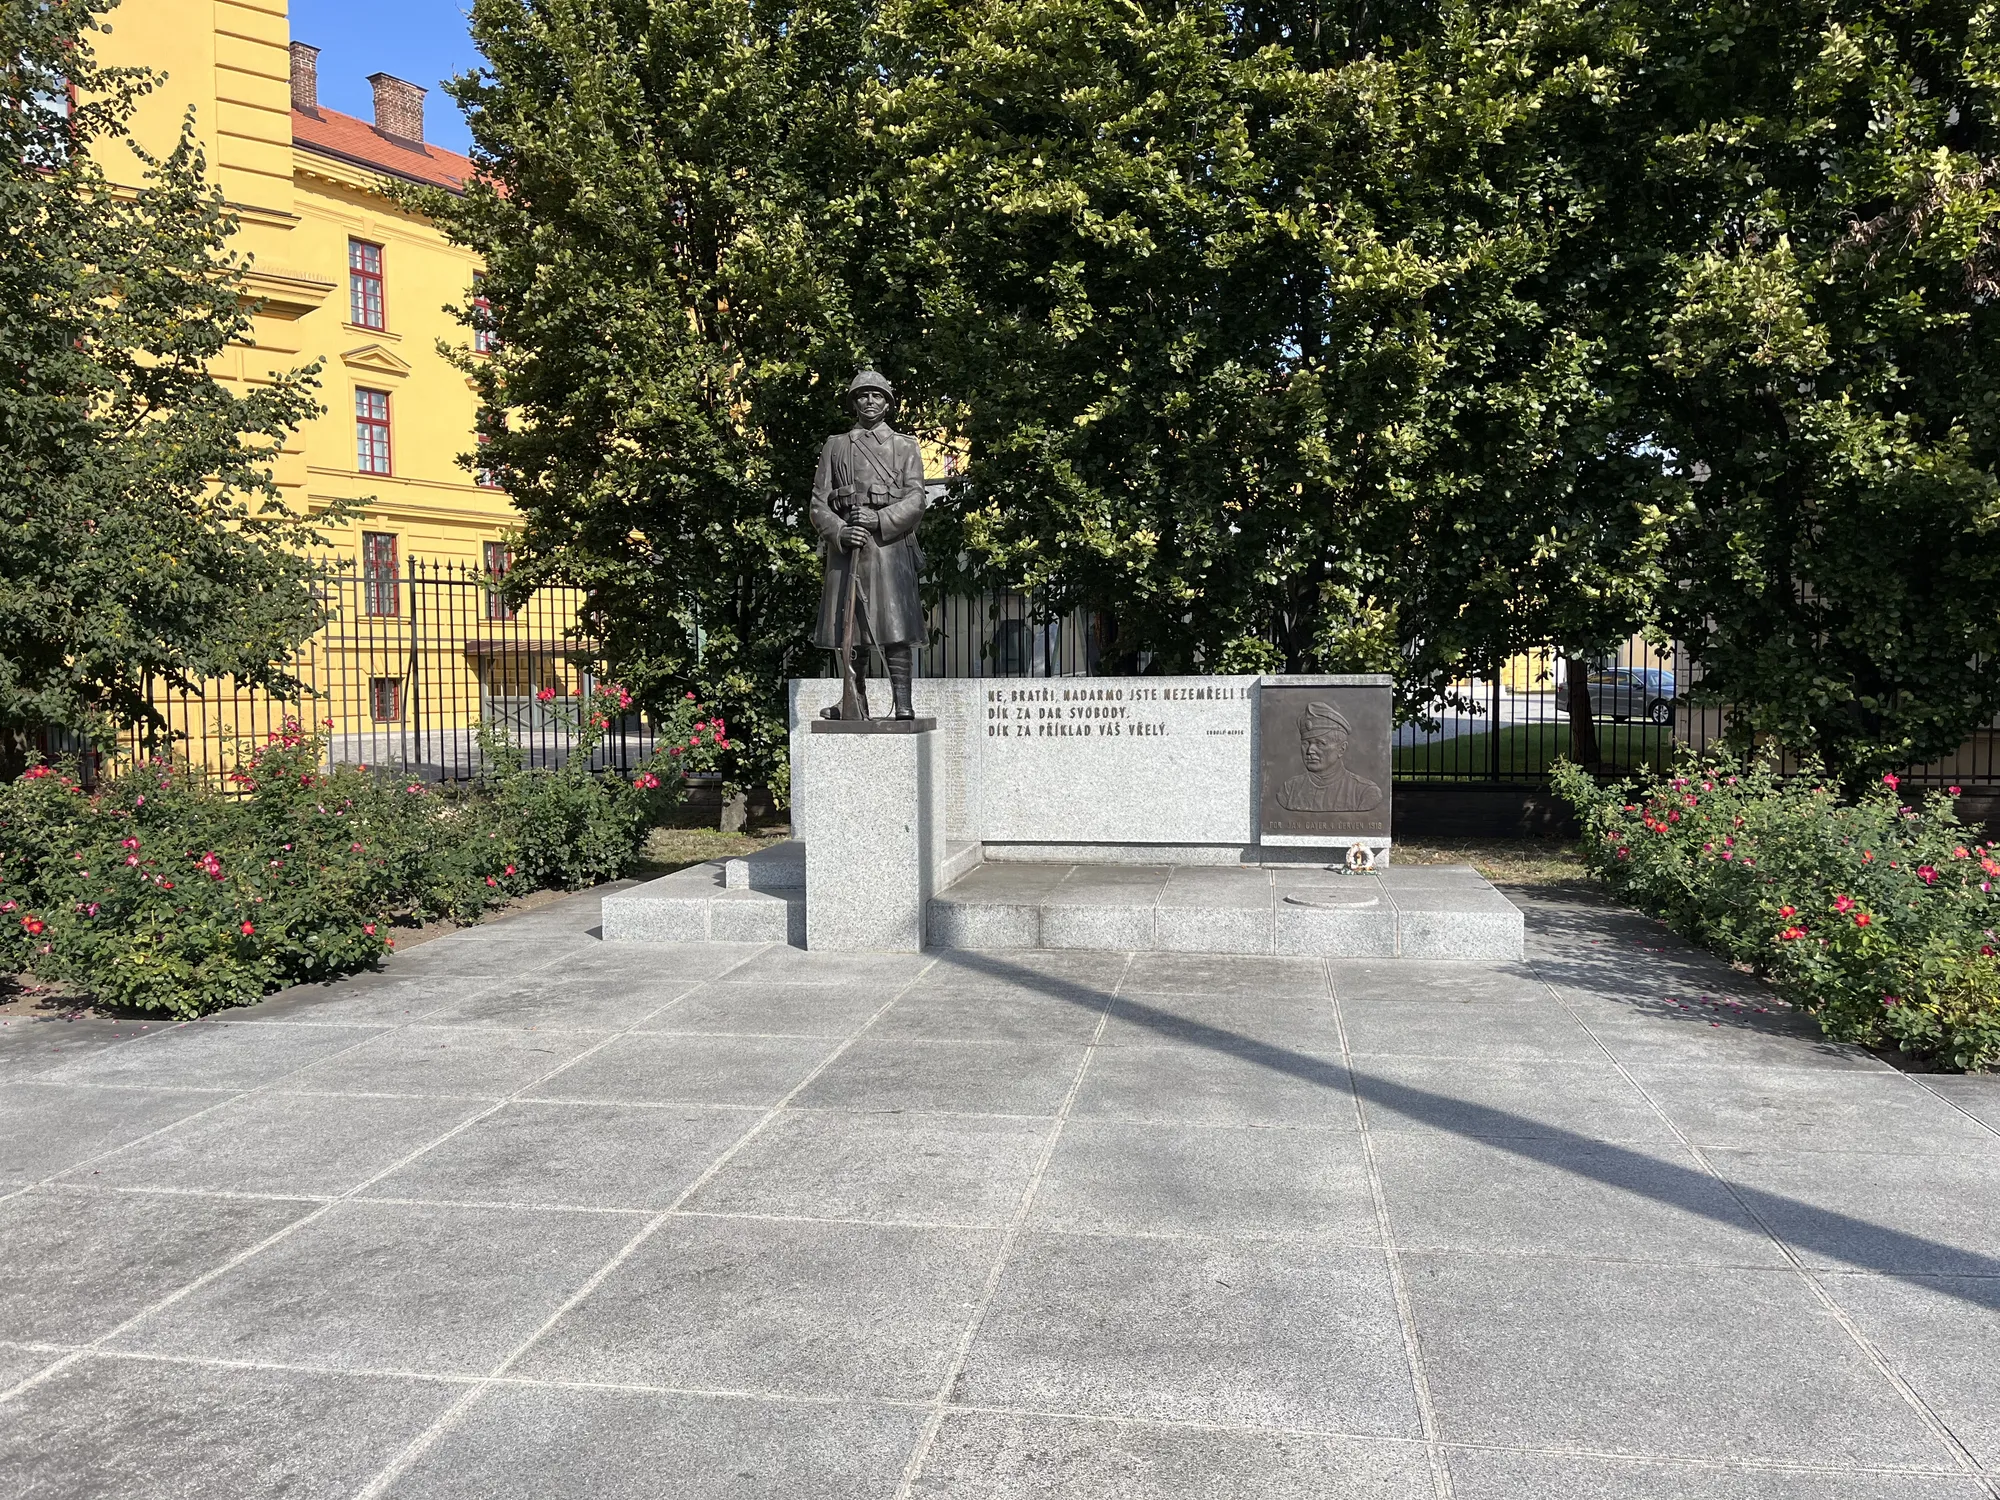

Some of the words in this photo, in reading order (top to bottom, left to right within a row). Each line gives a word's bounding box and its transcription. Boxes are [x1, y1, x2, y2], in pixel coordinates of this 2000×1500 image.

[988, 690, 1007, 703] NE,
[1011, 687, 1058, 703] BRATŘI,
[1063, 689, 1123, 701] NADARMO
[1129, 688, 1157, 701] JSTE
[1163, 686, 1234, 700] NEZEMŘELI
[988, 705, 1008, 719] DÍK
[1016, 707, 1031, 719] ZA
[1039, 707, 1062, 719] DAR
[988, 723, 1009, 736] DÍK
[1016, 724, 1031, 736] ZA
[1039, 722, 1091, 736] PŘÍKLAD
[1099, 722, 1121, 736] VÁŠ
